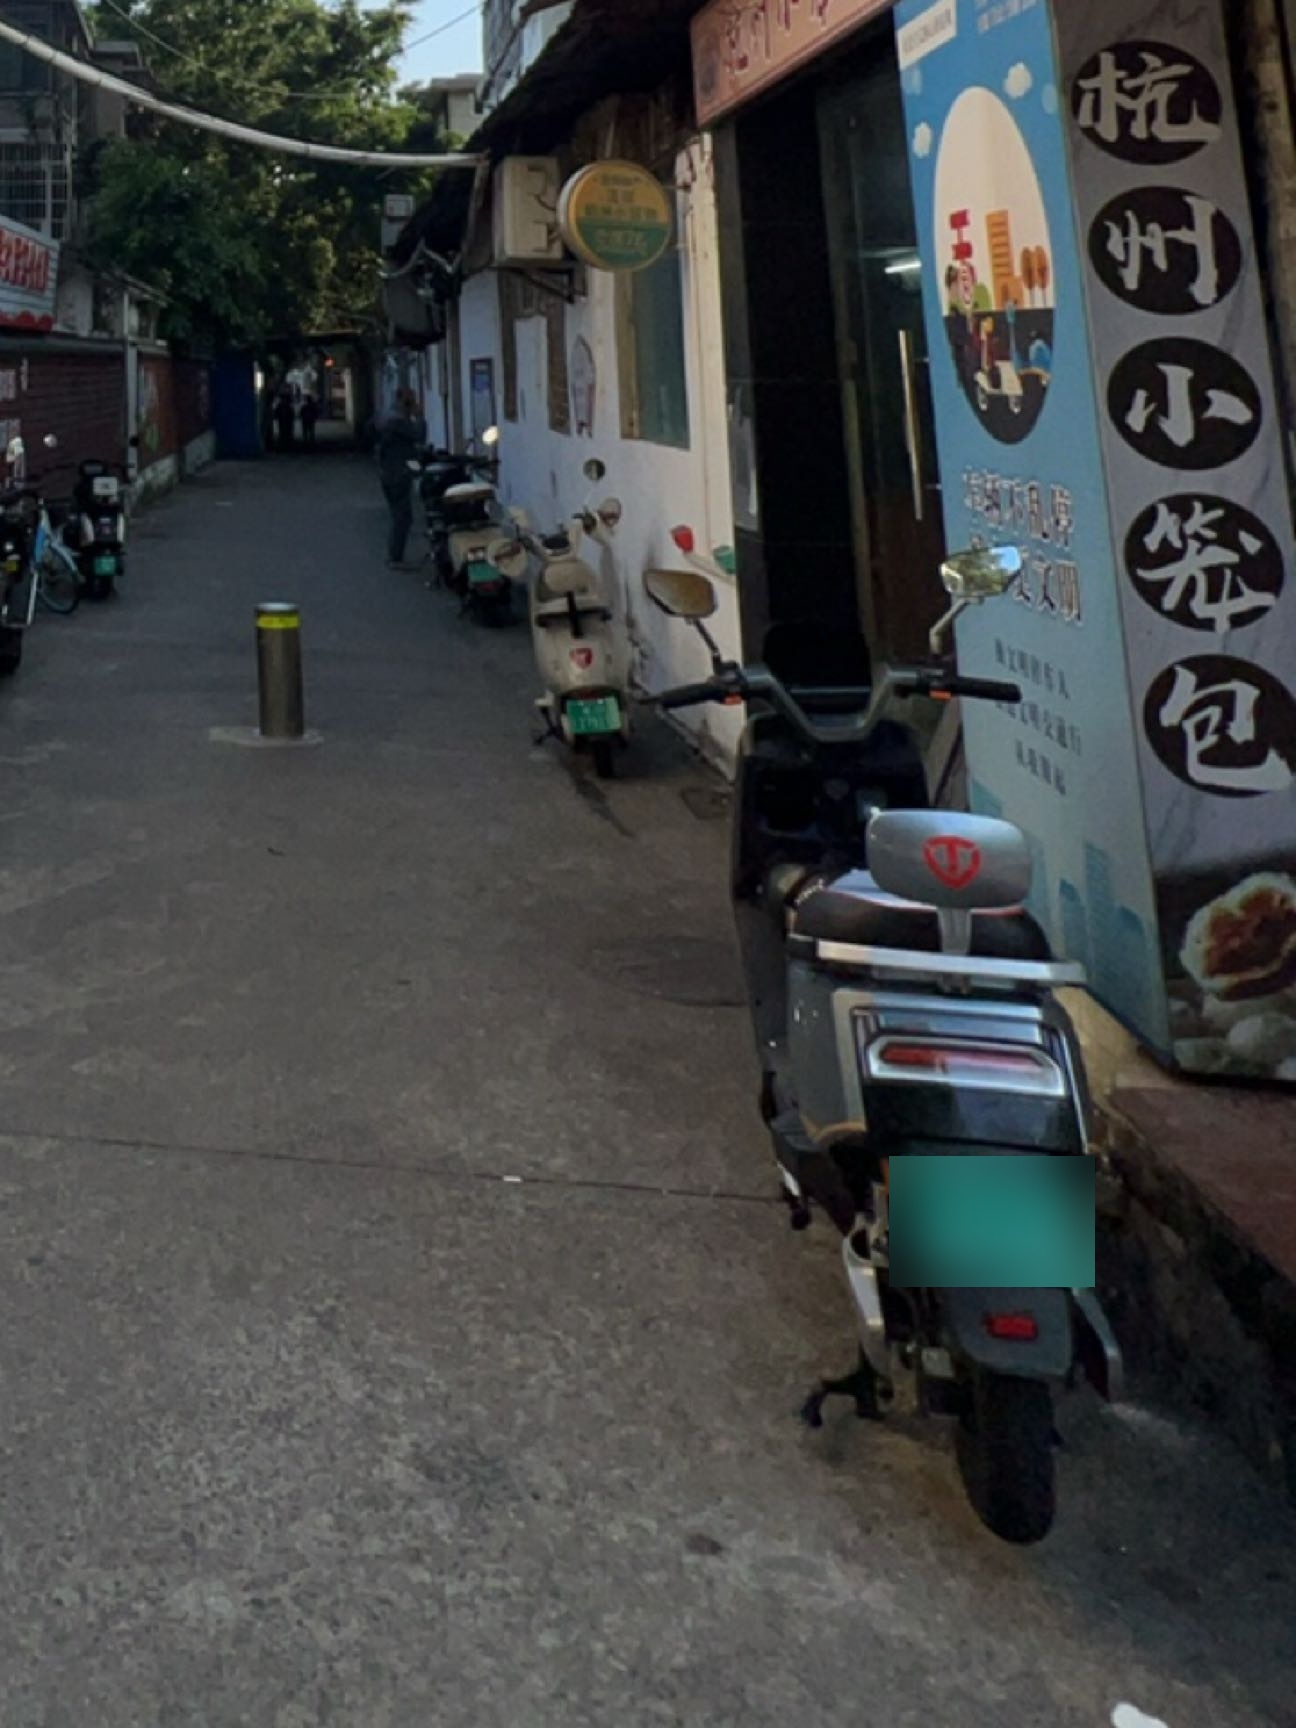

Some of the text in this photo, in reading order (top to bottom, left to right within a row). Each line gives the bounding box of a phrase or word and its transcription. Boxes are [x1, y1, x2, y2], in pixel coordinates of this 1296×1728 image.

[1078, 50, 1292, 792] 杭州小笼包
